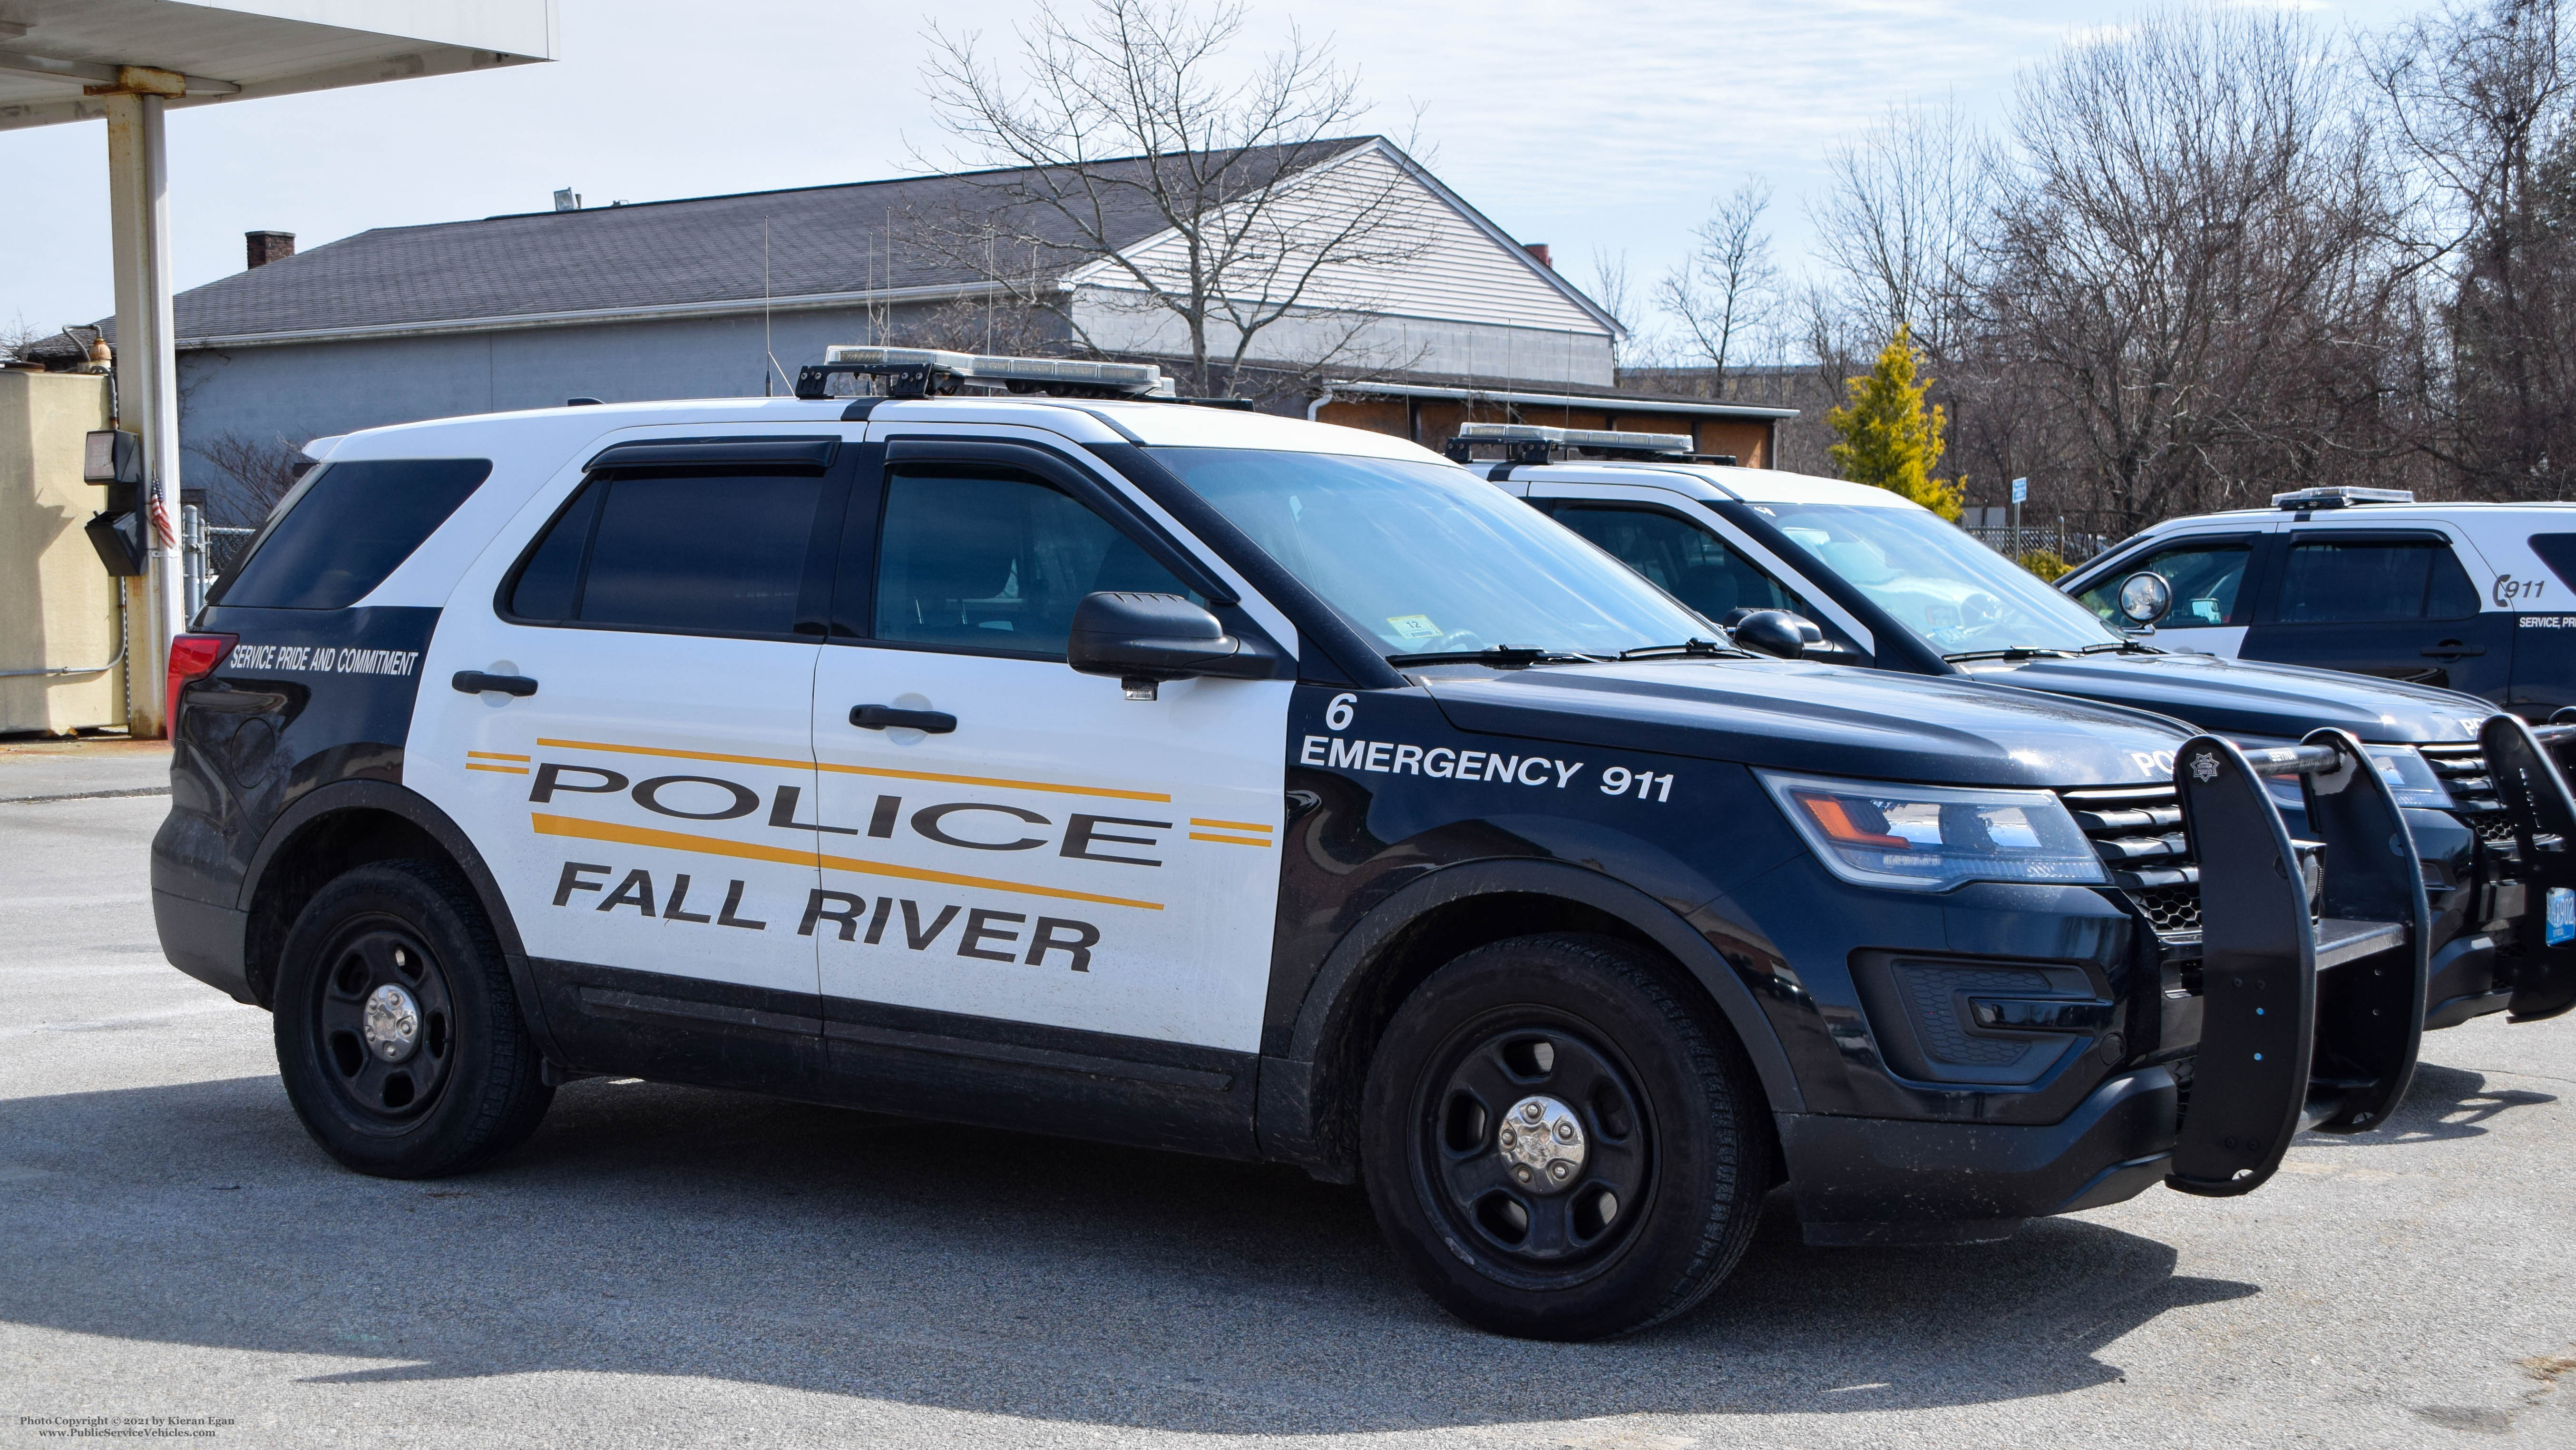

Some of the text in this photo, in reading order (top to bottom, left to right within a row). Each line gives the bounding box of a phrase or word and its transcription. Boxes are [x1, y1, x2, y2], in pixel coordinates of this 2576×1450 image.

[2503, 580, 2545, 598] 911
[1406, 620, 1422, 628] 12
[2519, 617, 2561, 629] SERVICE,
[230, 644, 419, 676] SERVICE PRIDE AND COMMITMENT
[1326, 693, 1357, 731] 6
[2458, 717, 2486, 737] PO
[1300, 735, 1674, 803] EMERGENCY 911
[2130, 750, 2176, 777] PO
[2268, 750, 2295, 762] SETINA
[528, 763, 1173, 867] POLICE
[552, 861, 1100, 973] FALL RIVER
